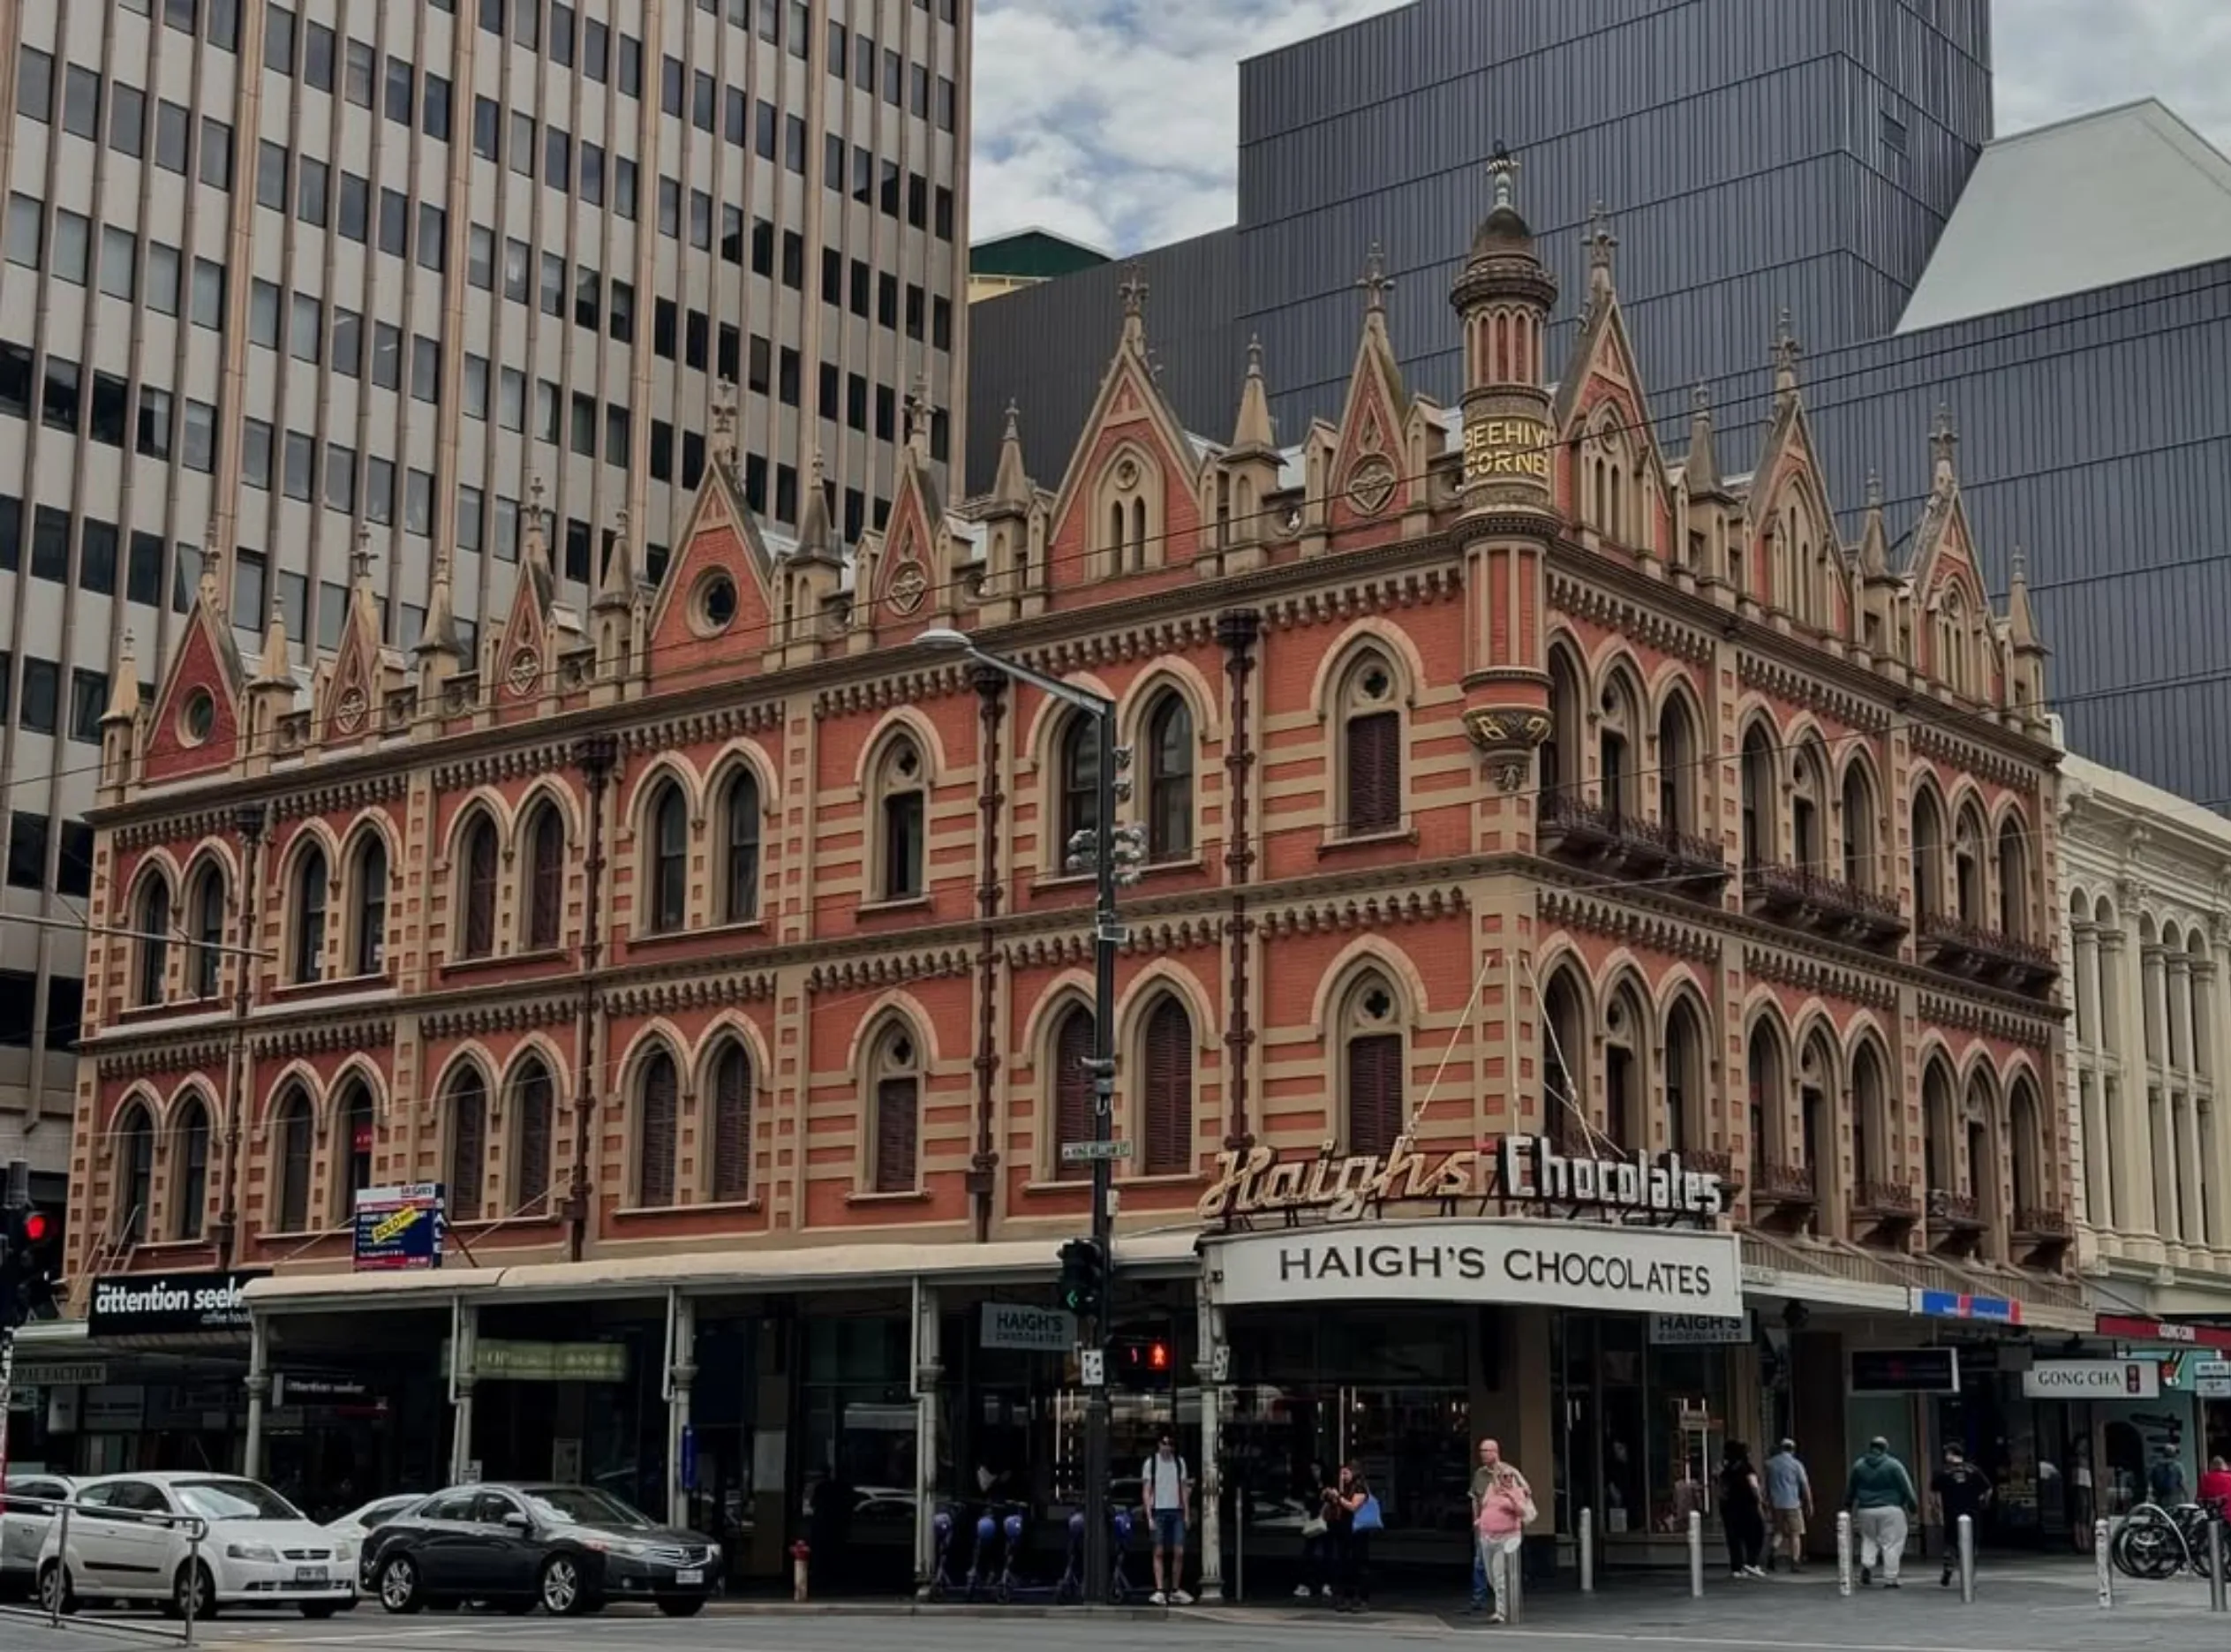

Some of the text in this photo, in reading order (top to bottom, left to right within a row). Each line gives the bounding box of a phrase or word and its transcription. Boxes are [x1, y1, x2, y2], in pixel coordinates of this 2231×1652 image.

[1464, 421, 1546, 452] BEEHIV
[1464, 451, 1548, 478] CORNE
[1505, 1135, 1722, 1215] Chocolates
[1280, 1246, 1710, 1296] HAIGH'S CHOCOLATES
[96, 1276, 244, 1314] attention seek
[997, 1312, 1064, 1331] HAIGH'S
[2038, 1370, 2084, 1385] GONG
[2088, 1370, 2122, 1386] CHA
